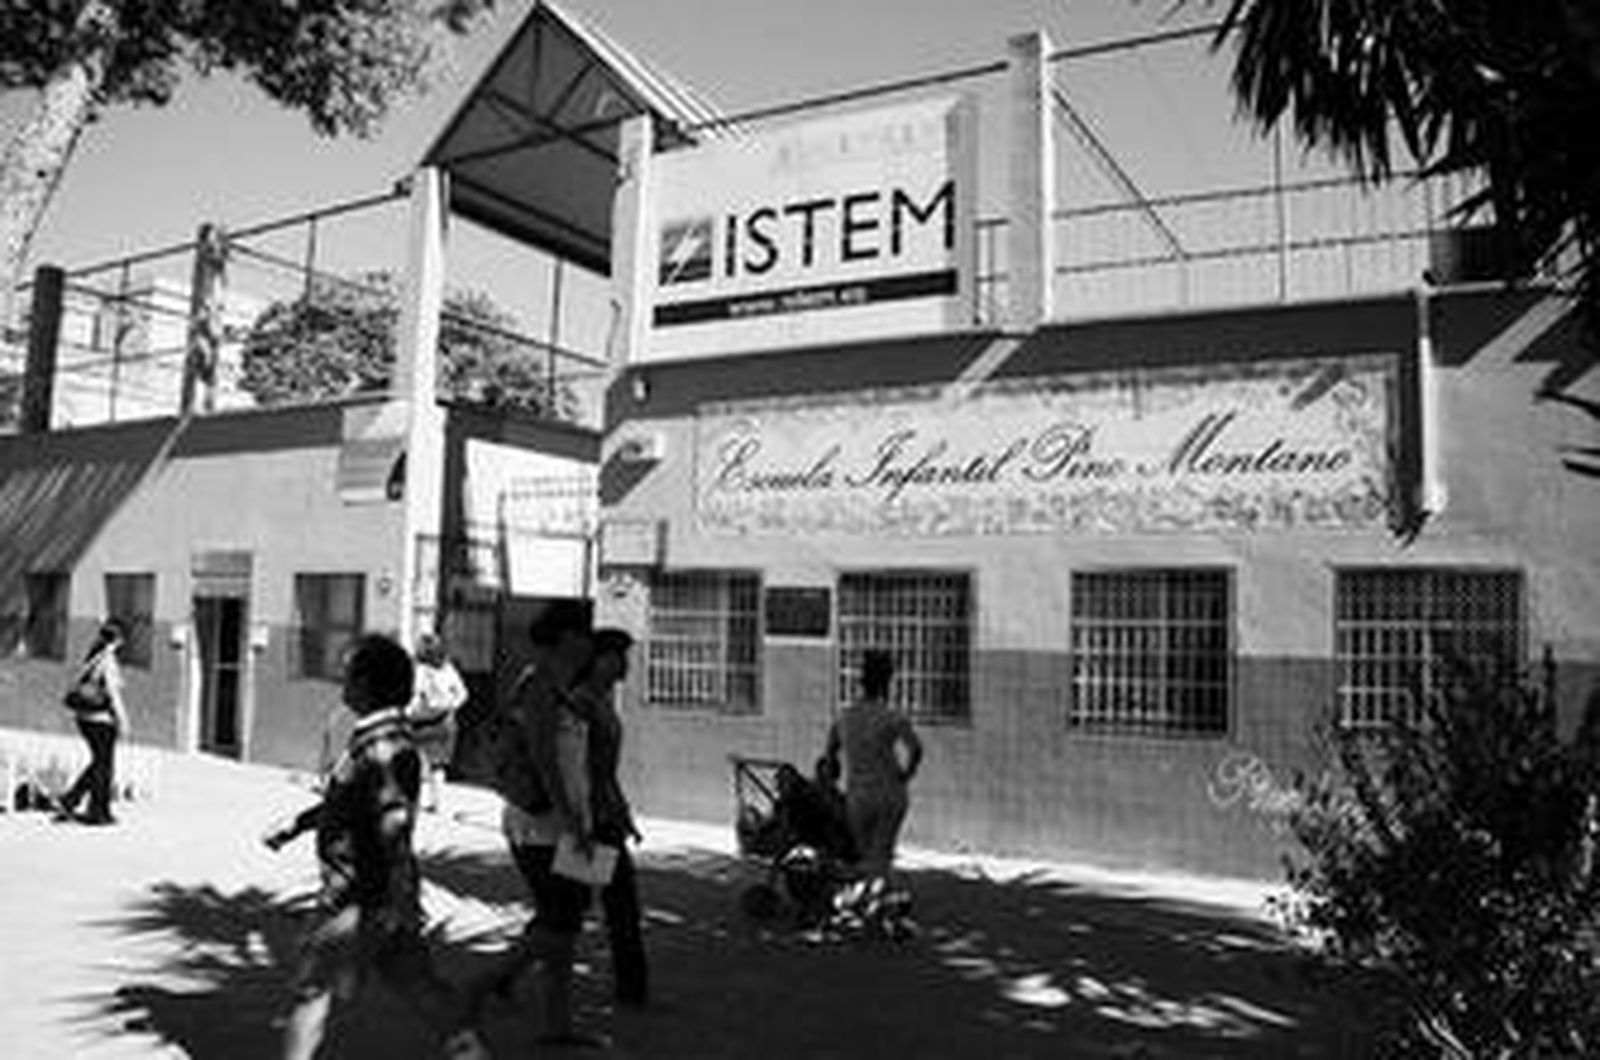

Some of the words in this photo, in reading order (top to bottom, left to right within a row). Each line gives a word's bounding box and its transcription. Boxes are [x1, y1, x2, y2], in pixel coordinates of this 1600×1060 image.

[725, 179, 955, 277] ISTEM
[716, 437, 842, 493] Escuela
[844, 429, 1028, 502] Infantil
[1021, 422, 1125, 483] Pino
[1136, 409, 1352, 476] Montano
